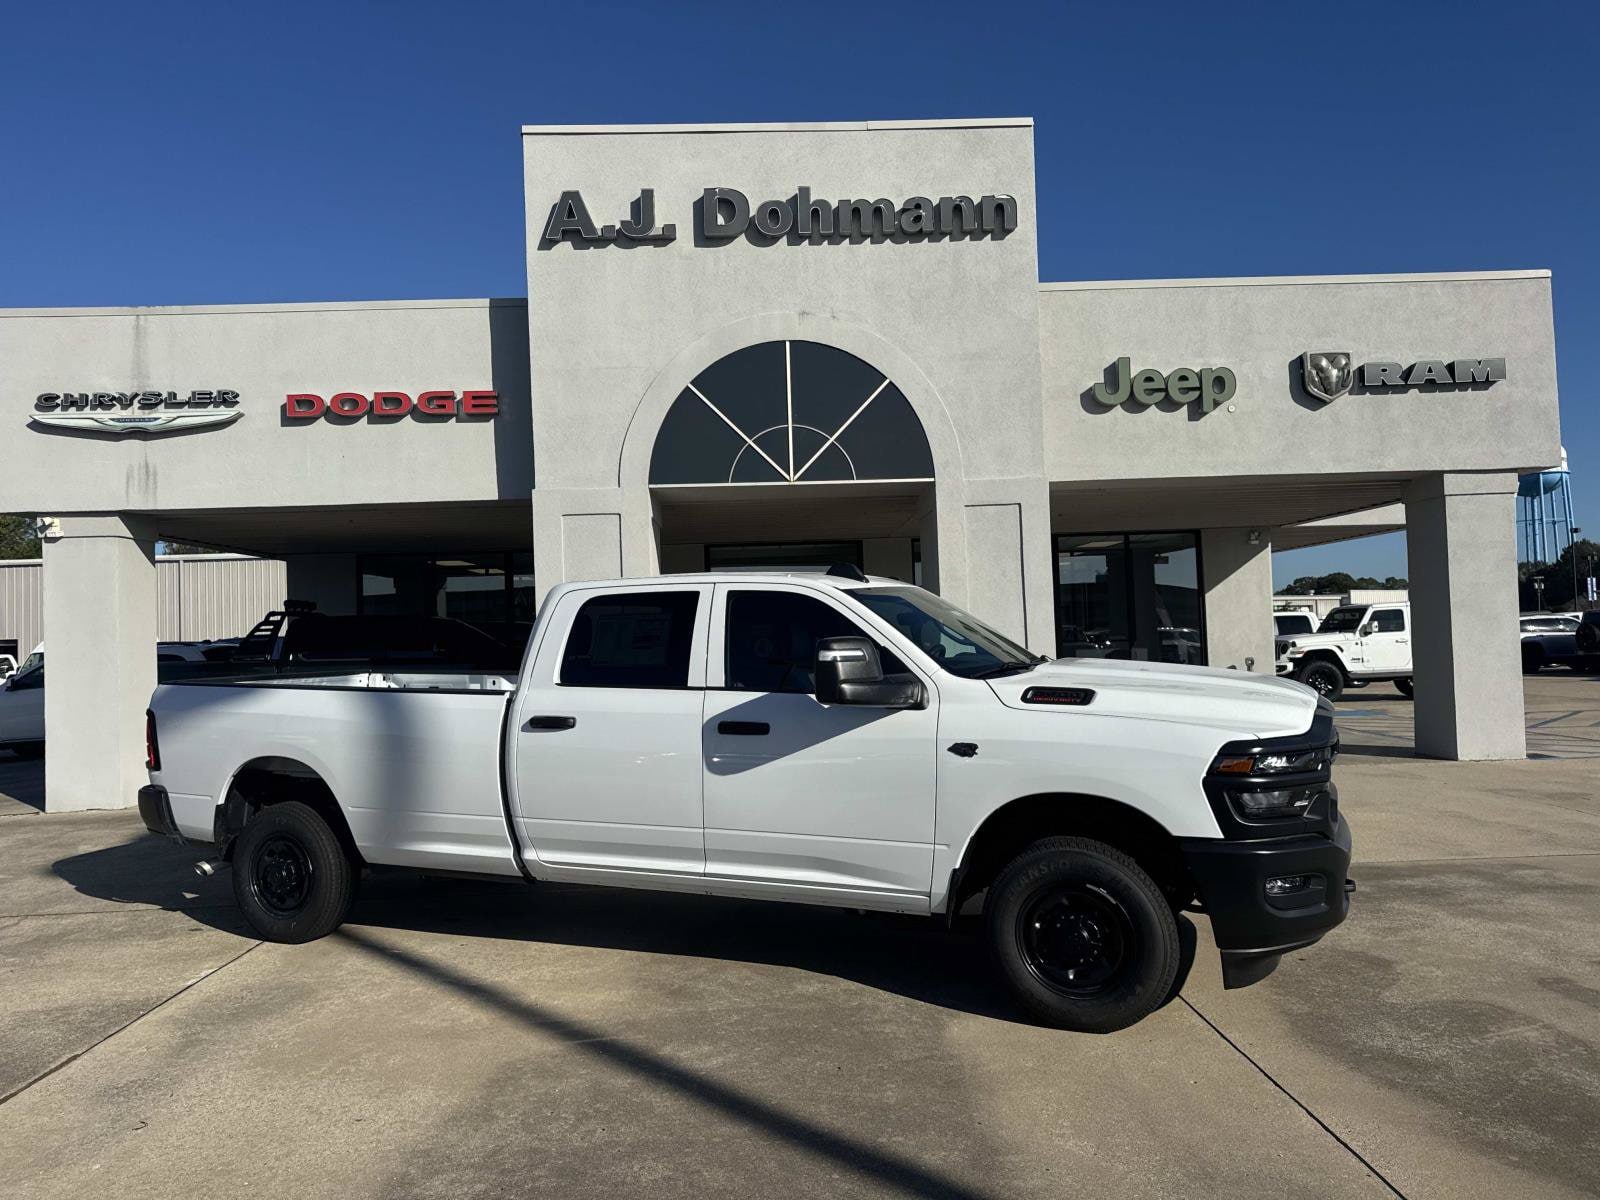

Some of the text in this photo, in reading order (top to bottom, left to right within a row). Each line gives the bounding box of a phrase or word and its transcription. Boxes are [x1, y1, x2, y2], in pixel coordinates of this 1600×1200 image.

[545, 185, 1019, 240] A.J. Dohmann
[1093, 356, 1237, 413] Jeep
[1363, 357, 1507, 387] RAM
[36, 388, 240, 407] CHRYSLER
[285, 390, 499, 420] DODGE
